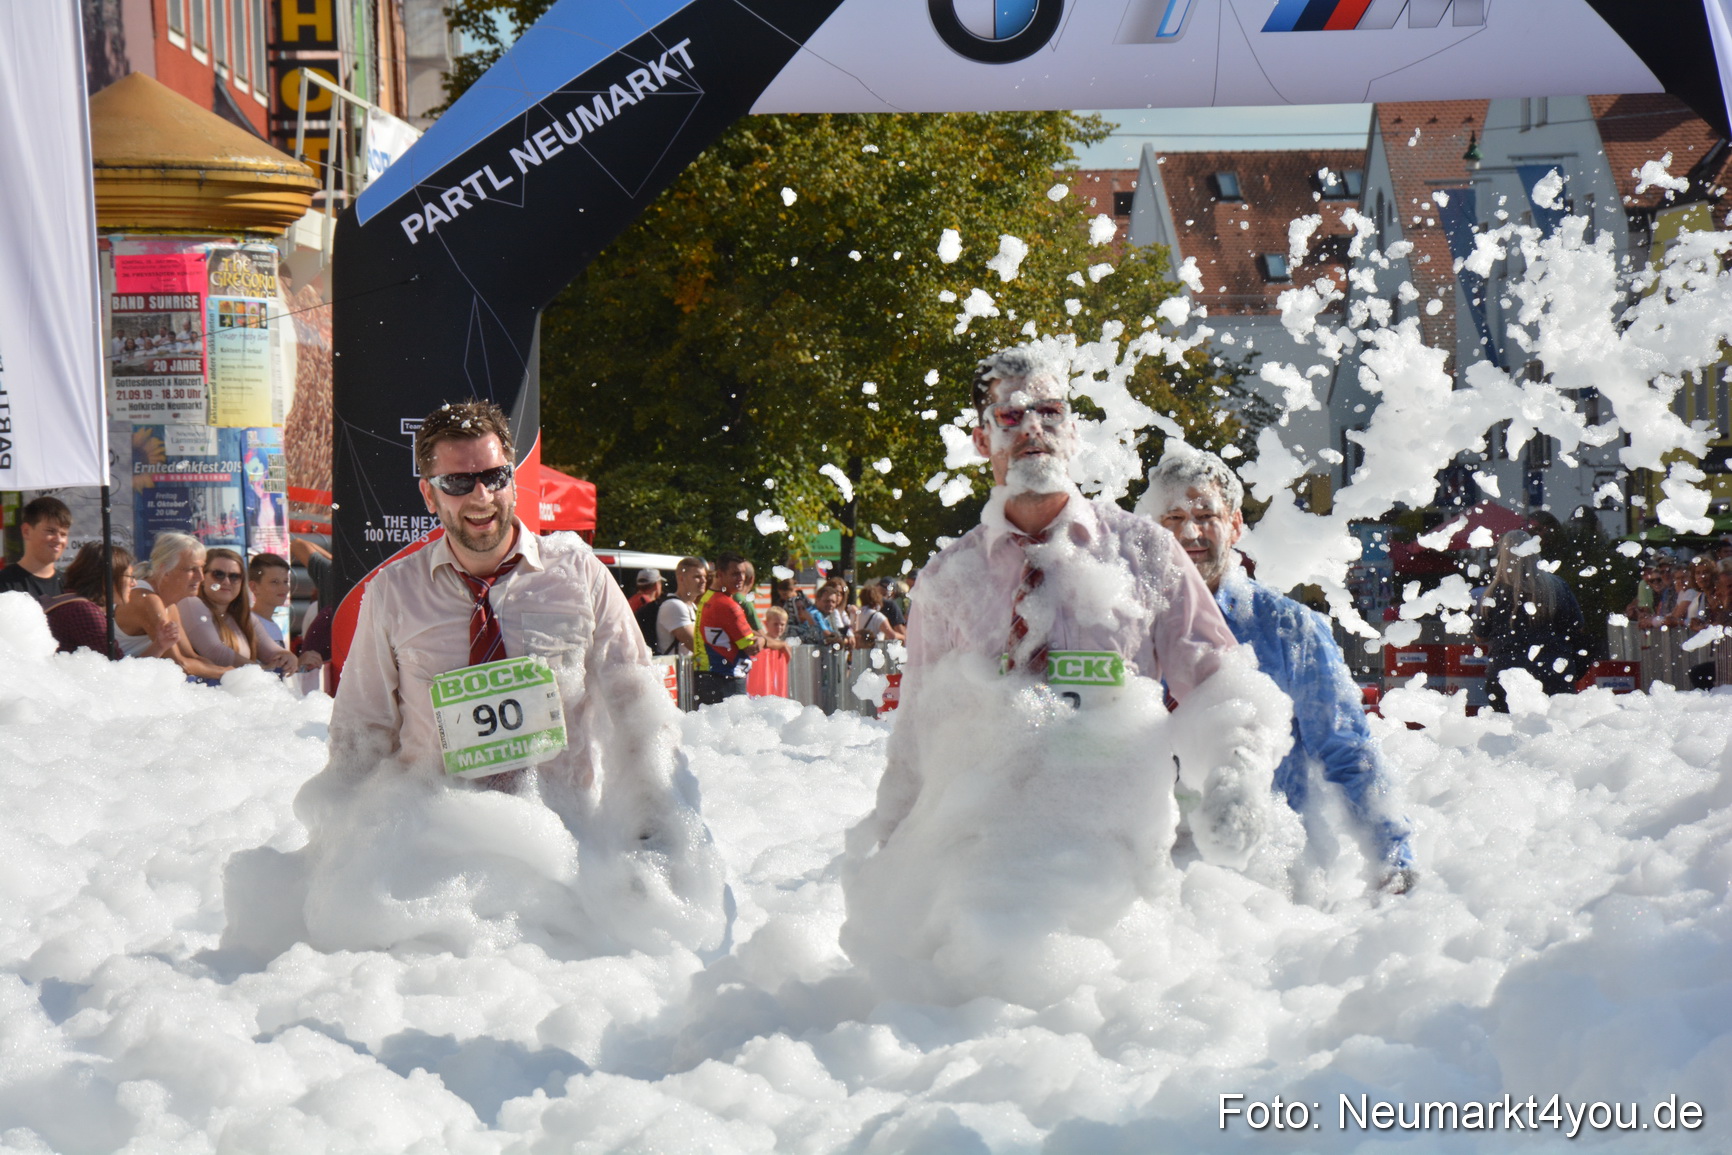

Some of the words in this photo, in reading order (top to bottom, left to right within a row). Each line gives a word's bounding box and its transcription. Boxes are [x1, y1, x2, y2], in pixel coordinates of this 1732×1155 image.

[400, 165, 514, 245] PARTL
[508, 37, 695, 175] NEUMARKT
[112, 295, 145, 310] BAND
[148, 295, 199, 309] SUNRISE
[153, 360, 168, 372] 20
[169, 359, 202, 372] JAHRE
[115, 378, 165, 388] Gottesdienst
[173, 377, 202, 387] Konzert
[116, 389, 153, 401] 21.09.19
[161, 389, 185, 400] 18.30
[186, 388, 202, 399] Uhr
[128, 402, 165, 412] Hofkirche
[167, 400, 203, 410] Neumarkt
[133, 461, 219, 474] Erntedankfest
[220, 460, 242, 473] 2019
[155, 491, 178, 501] Freitag
[156, 500, 186, 508] Oktober
[383, 515, 408, 528] THE
[364, 528, 384, 541] 100
[385, 529, 430, 543] YEARS
[710, 629, 723, 645] 7
[440, 661, 540, 701] BOCK
[472, 698, 524, 737] 90
[457, 738, 530, 768] MATTHI
